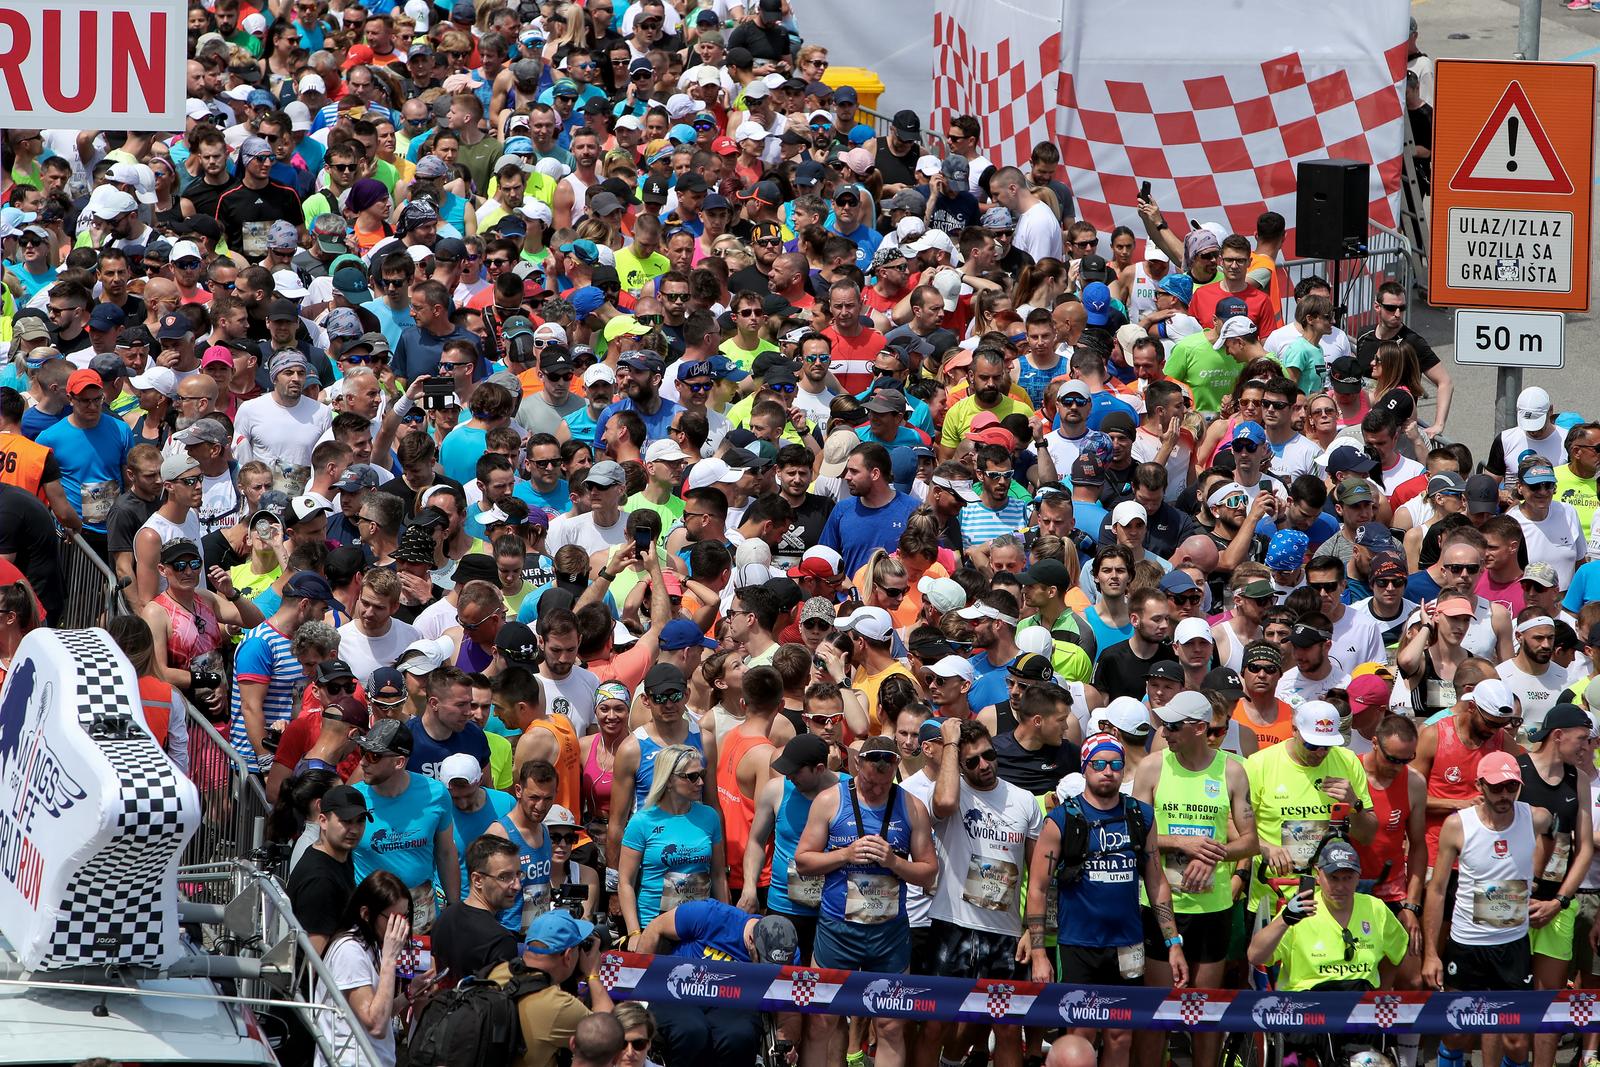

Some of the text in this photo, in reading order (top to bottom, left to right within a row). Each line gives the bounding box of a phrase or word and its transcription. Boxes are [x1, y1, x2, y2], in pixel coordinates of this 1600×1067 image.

[0, 8, 166, 113] RUN
[1459, 217, 1561, 237] ULAZ/IZLAZ
[1468, 241, 1553, 260] VOZILA SA
[1461, 262, 1557, 283] GRAIŠTA
[1475, 325, 1543, 352] 50 m
[1170, 825, 1212, 836] DECATHLON
[0, 808, 44, 912] RLDRUN
[1298, 846, 1316, 856] 5122
[1085, 860, 1119, 870] STRIA
[1092, 872, 1130, 881] BY UTMB
[1319, 962, 1372, 977] respect.
